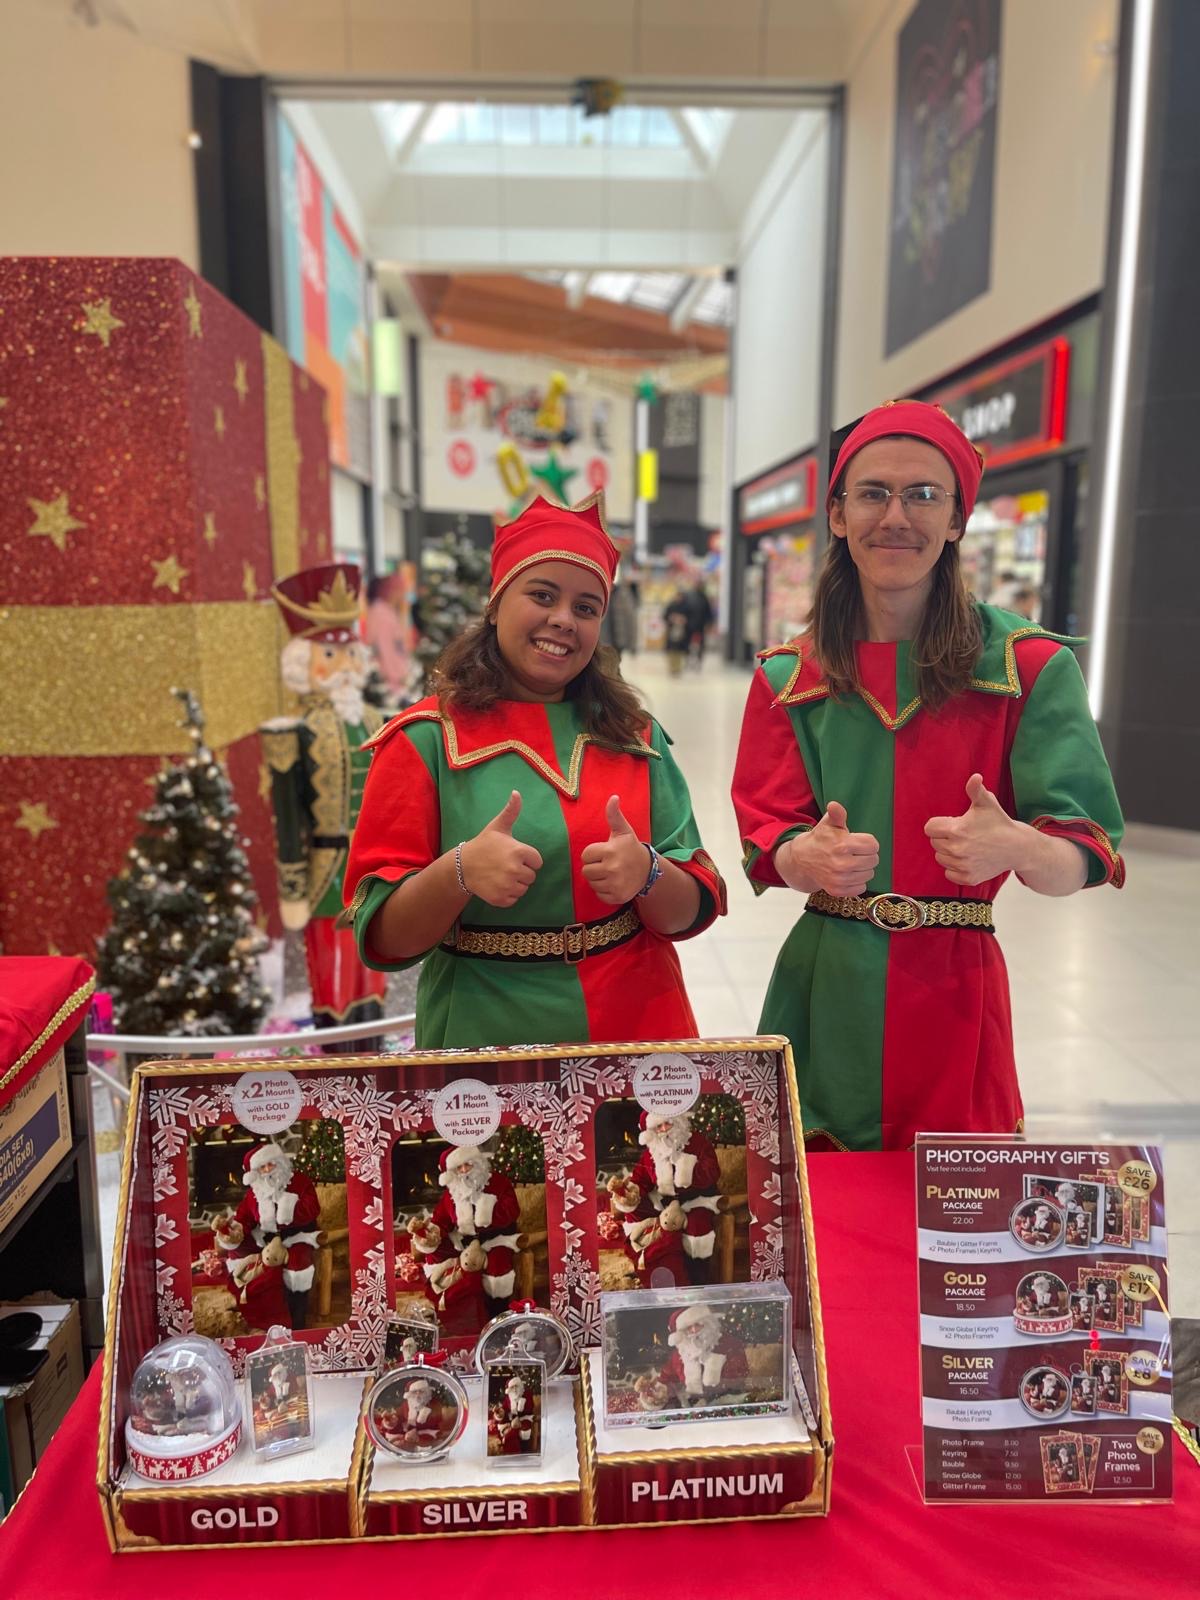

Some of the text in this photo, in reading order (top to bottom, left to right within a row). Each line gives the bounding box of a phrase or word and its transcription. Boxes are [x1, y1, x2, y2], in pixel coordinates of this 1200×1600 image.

[962, 391, 1016, 439] SHOP
[642, 1065, 662, 1081] x2
[242, 1081, 264, 1099] x2
[265, 1088, 294, 1096] Mounts
[654, 1088, 693, 1097] PLATINUM
[266, 1102, 290, 1111] GOLD
[445, 1094, 460, 1110] x1
[463, 1101, 489, 1109] Mount
[252, 1114, 286, 1122] Package
[461, 1117, 491, 1126] SILVER
[452, 1128, 485, 1136] Package
[926, 1150, 1110, 1165] PHOTOGRAPHY GIFTS
[1125, 1166, 1151, 1178] SAVE
[1122, 1177, 1150, 1190] £26
[926, 1185, 1000, 1199] PLATINUM
[952, 1217, 974, 1225] 22.00
[943, 1271, 987, 1285] GOLD
[1129, 1271, 1154, 1283] SAVE
[945, 1288, 986, 1296] PACKAGE
[1127, 1282, 1150, 1295] £17
[956, 1303, 975, 1311] 18.50
[942, 1355, 994, 1369] SILVER
[1132, 1356, 1158, 1368] SAVE
[948, 1372, 989, 1380] PACKAGE
[1133, 1368, 1151, 1380] £8
[959, 1387, 979, 1395] 16.50
[1141, 1431, 1160, 1441] SAVE
[1112, 1441, 1132, 1449] Two
[942, 1450, 967, 1458] Keyring
[1108, 1451, 1137, 1460] Photo
[1104, 1462, 1140, 1471] Frames
[1113, 1476, 1132, 1484] 12.50
[632, 1473, 783, 1502] PLATINUM
[423, 1500, 528, 1525] SILVER
[190, 1506, 279, 1530] GOLD
